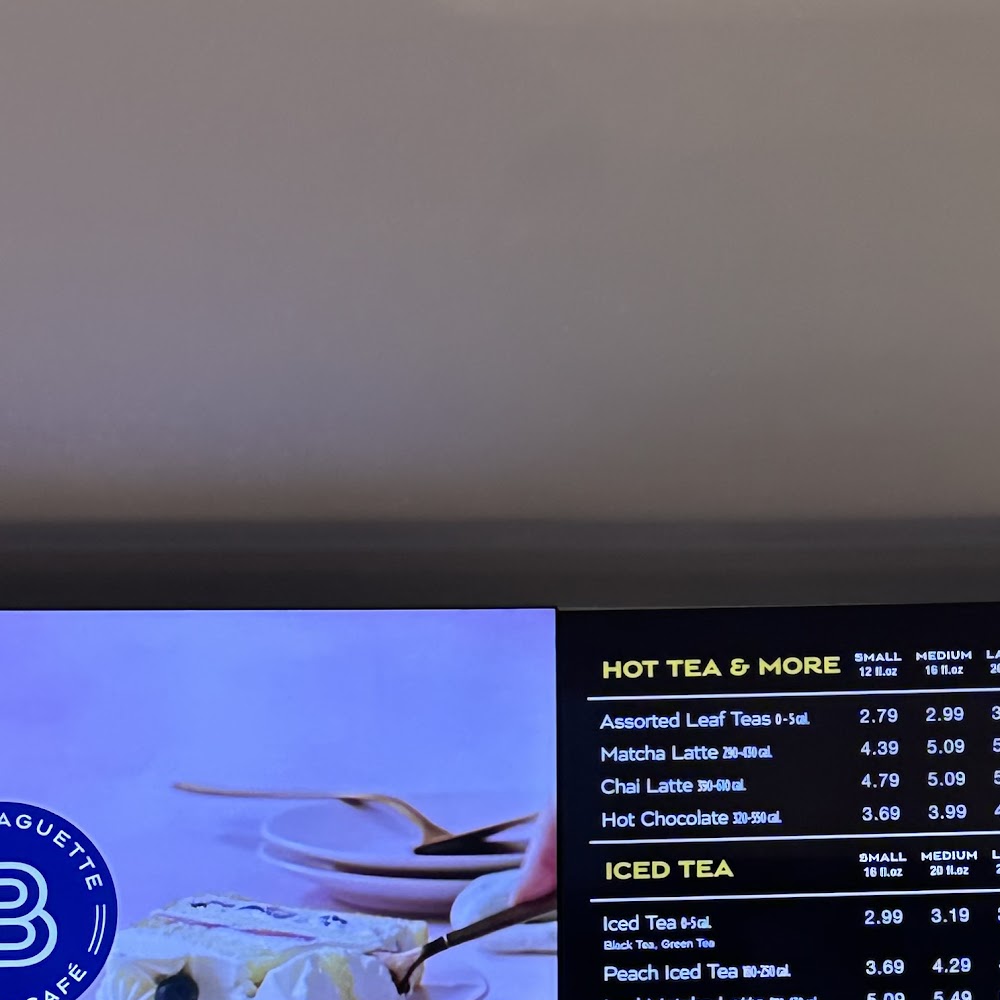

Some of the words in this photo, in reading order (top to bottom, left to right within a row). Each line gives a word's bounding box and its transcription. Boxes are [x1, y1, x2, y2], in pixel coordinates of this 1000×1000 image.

[603, 660, 660, 679] HOT
[666, 658, 722, 678] TEA
[730, 658, 750, 676] &
[759, 656, 841, 676] MORE
[854, 652, 903, 663] SMALL
[916, 650, 972, 661] MEDIUM
[599, 711, 680, 730] Assorted
[686, 710, 727, 728] Leaf
[730, 710, 772, 727] Teas
[859, 708, 898, 724] 2.79
[926, 706, 965, 722] 2.99
[601, 744, 666, 762] Matcha
[672, 745, 720, 761] Latte
[860, 740, 899, 756] 4.39
[927, 738, 965, 754] 5.09
[600, 778, 640, 795] Chai
[646, 778, 694, 794] Latte
[602, 812, 636, 828] Hot
[640, 809, 730, 827] Chocolate
[606, 861, 671, 880] ICED
[678, 859, 734, 878] TEA
[603, 914, 640, 932] Iced
[644, 914, 677, 931] Tea
[864, 909, 904, 925] 2.99
[931, 907, 970, 924] 3.19
[604, 964, 660, 982] Peach
[665, 962, 702, 981] Iced
[706, 963, 739, 980] Tea
[866, 959, 905, 976] 3.69
[932, 957, 972, 974] 4.29
